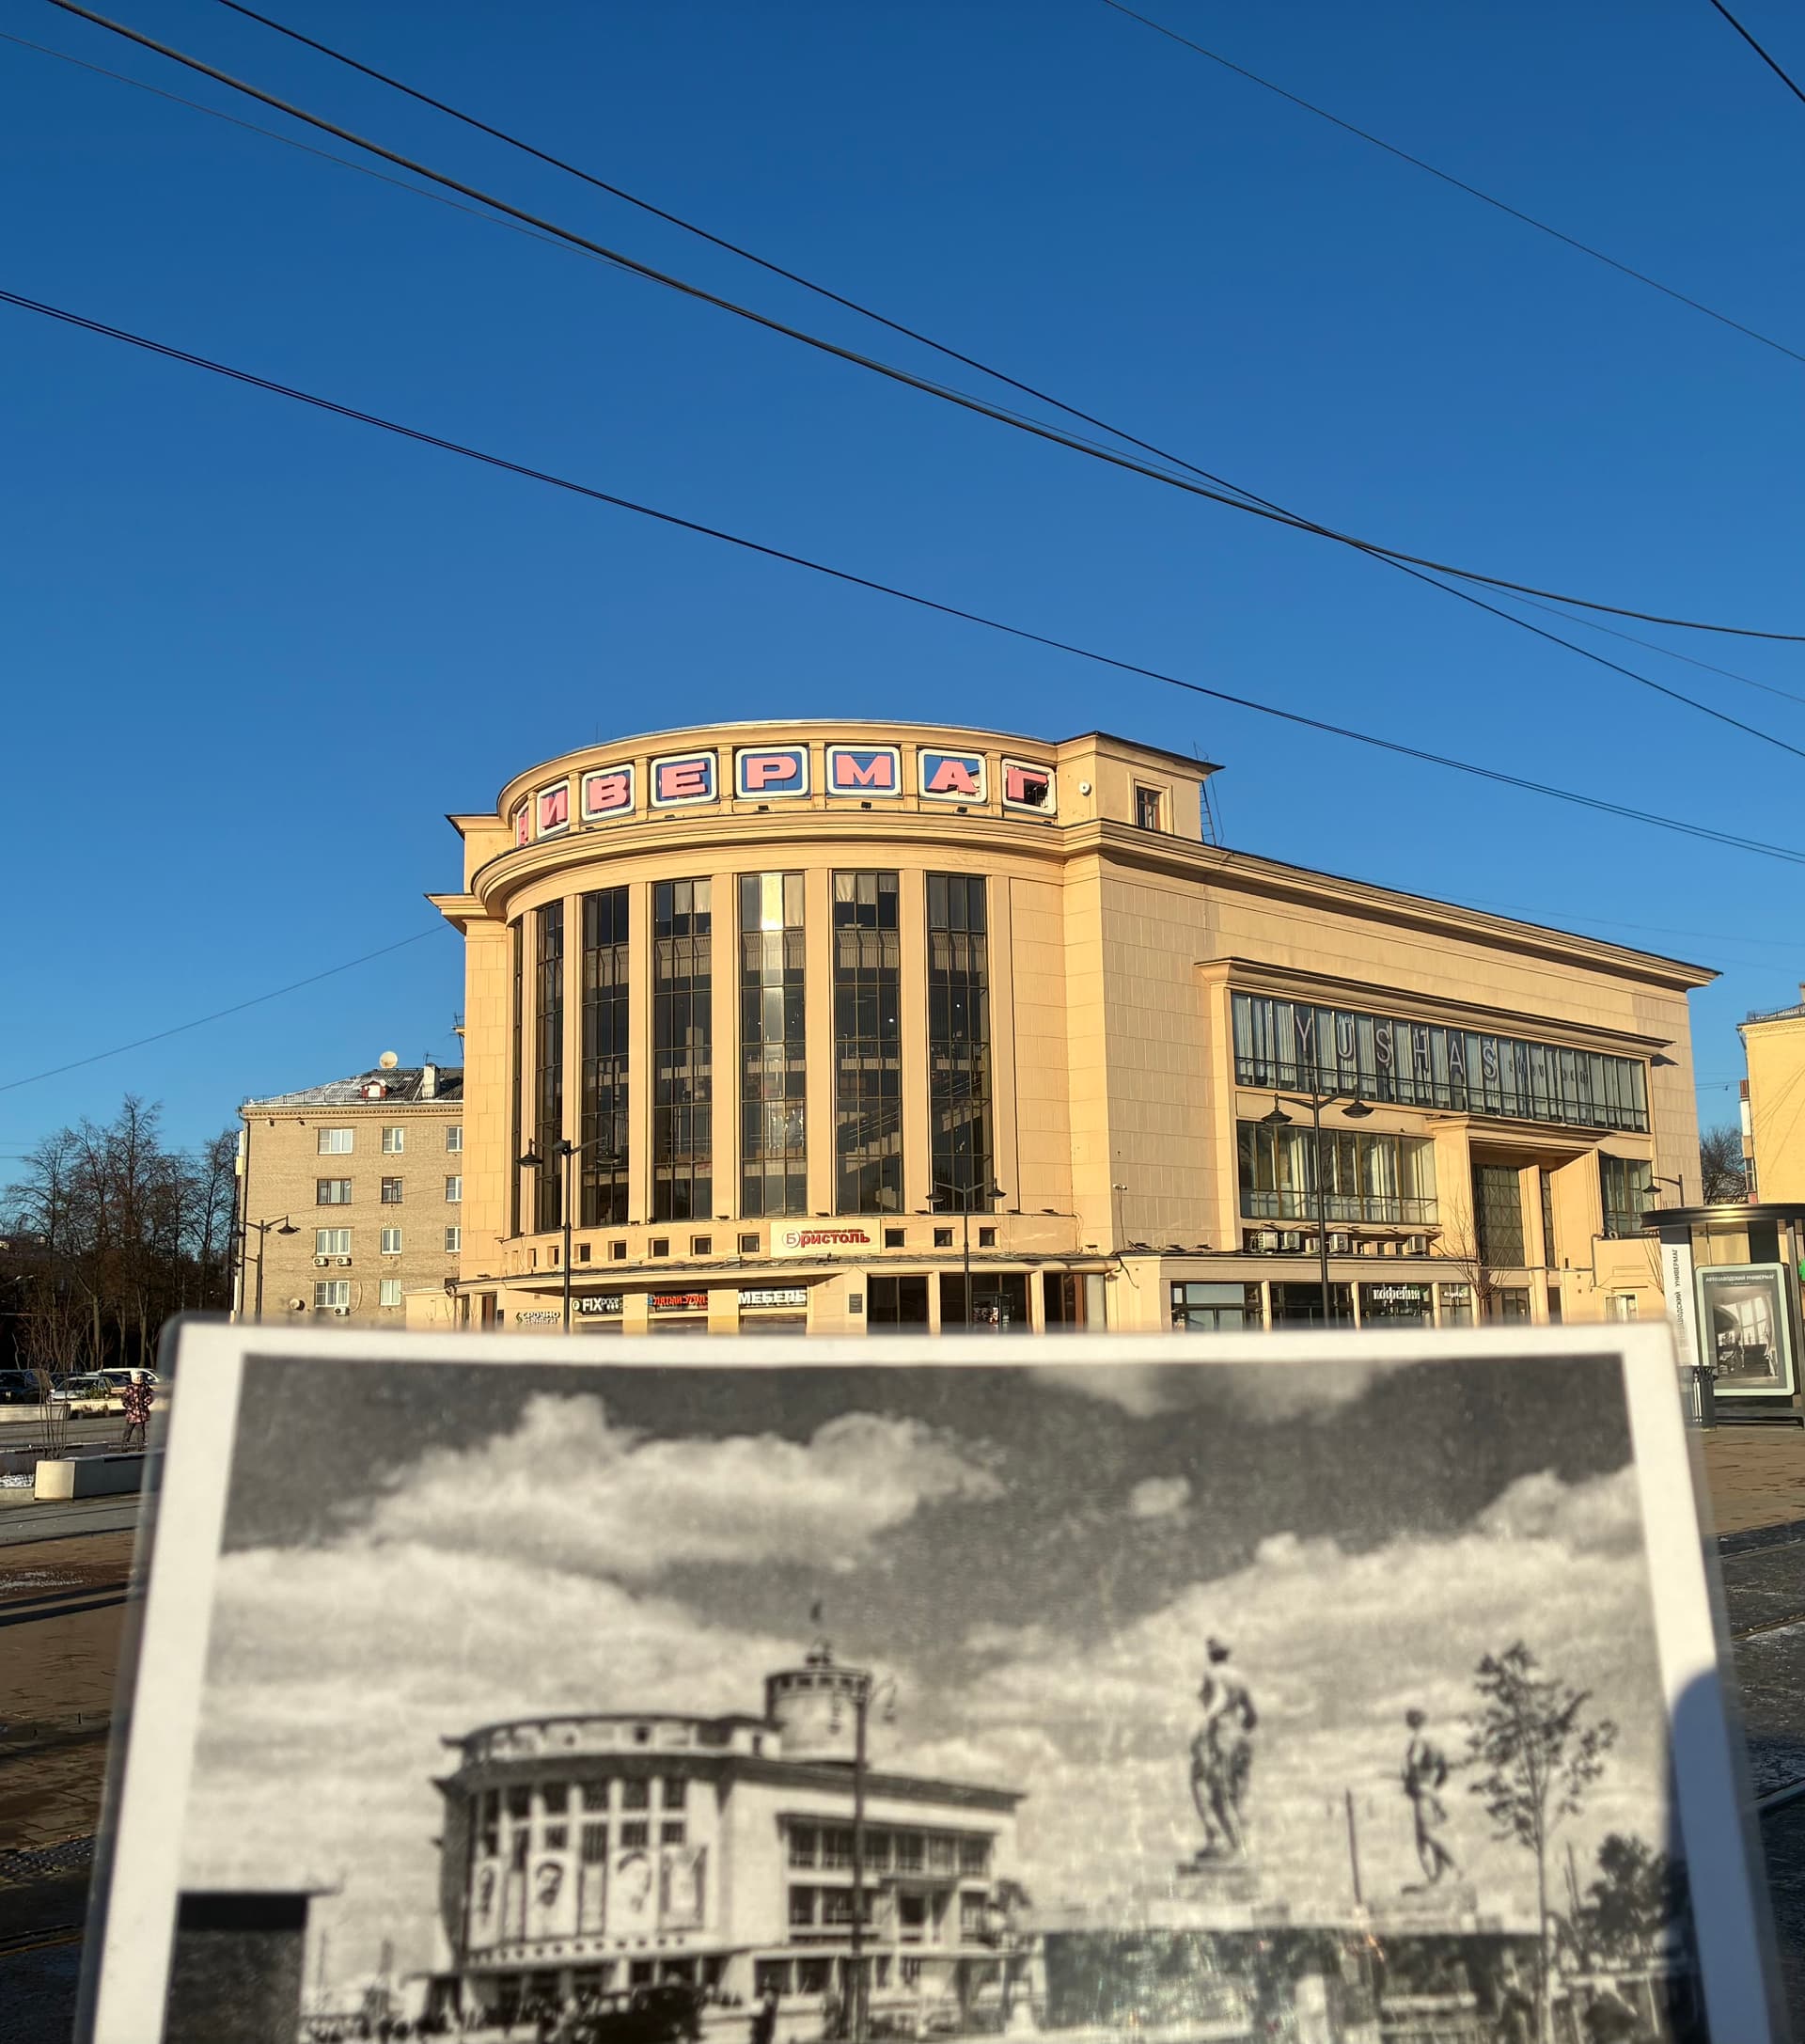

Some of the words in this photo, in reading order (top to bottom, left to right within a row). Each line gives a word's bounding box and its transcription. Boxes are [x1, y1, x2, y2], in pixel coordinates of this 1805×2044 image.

[1295, 1014, 1497, 1078] YUSHAS
[784, 1231, 871, 1248] Бристоль
[582, 1297, 602, 1312] FIX
[738, 1289, 807, 1305] МЕБЕЛЬ
